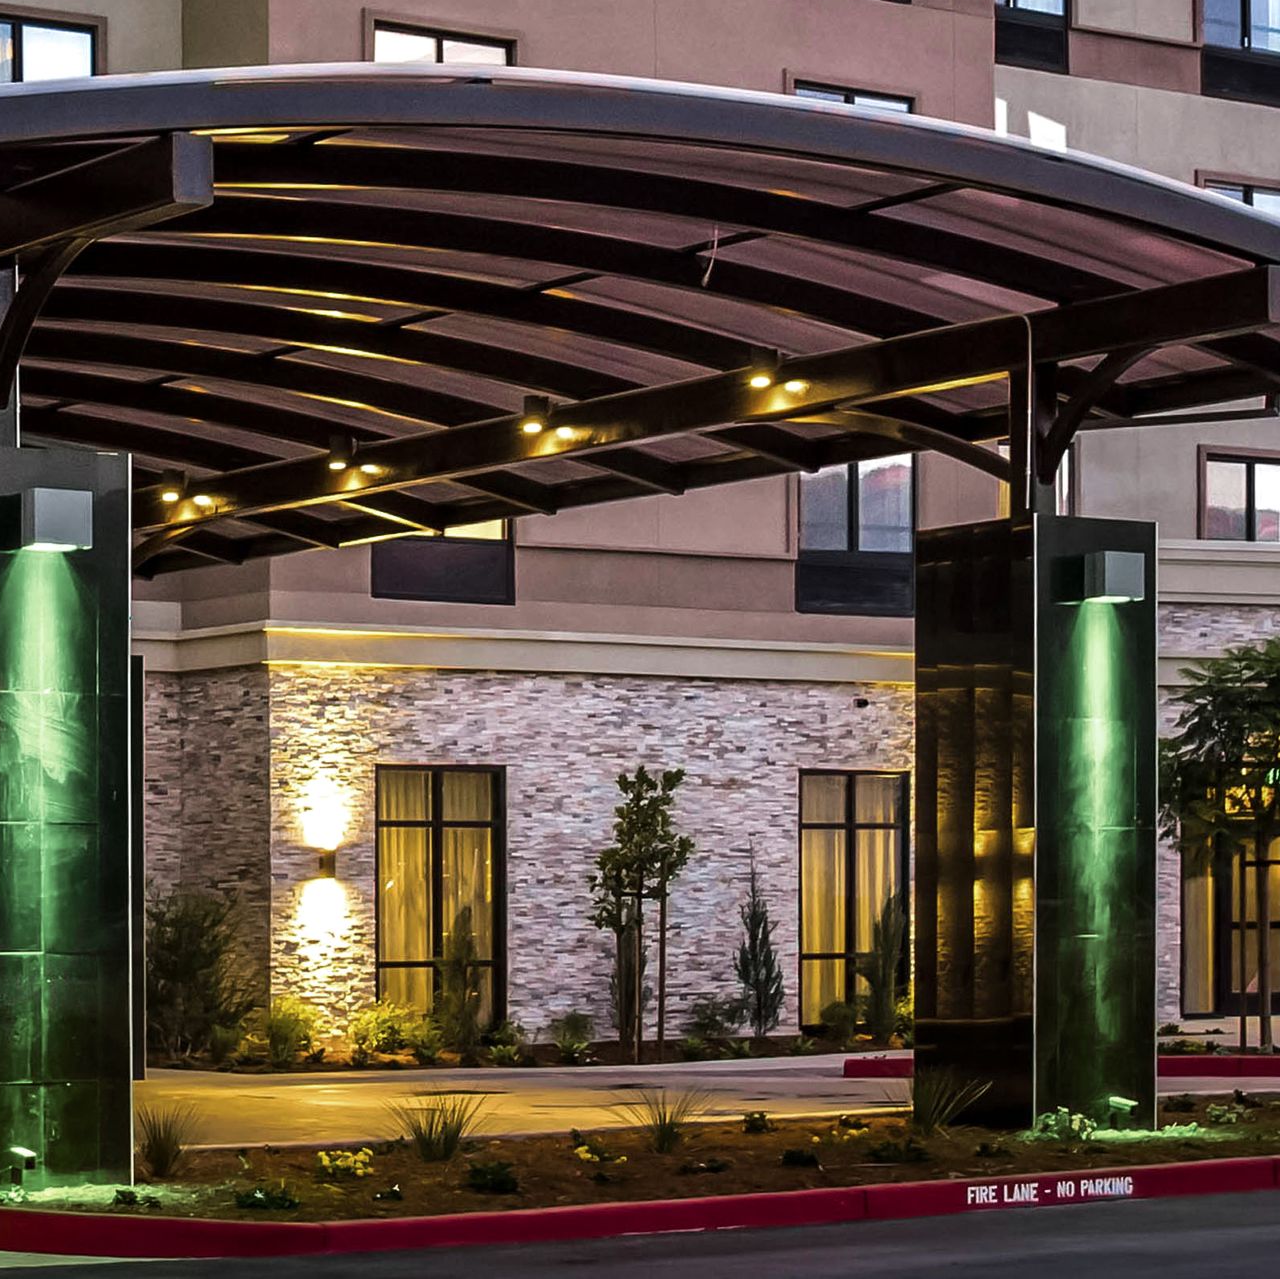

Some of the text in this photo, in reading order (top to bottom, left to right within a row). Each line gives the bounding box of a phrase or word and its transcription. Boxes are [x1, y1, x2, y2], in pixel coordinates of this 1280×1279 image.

[967, 1186, 998, 1204] FIRE
[1004, 1183, 1039, 1203] LANE
[1057, 1181, 1075, 1198] NO
[1080, 1177, 1133, 1196] PARKING
